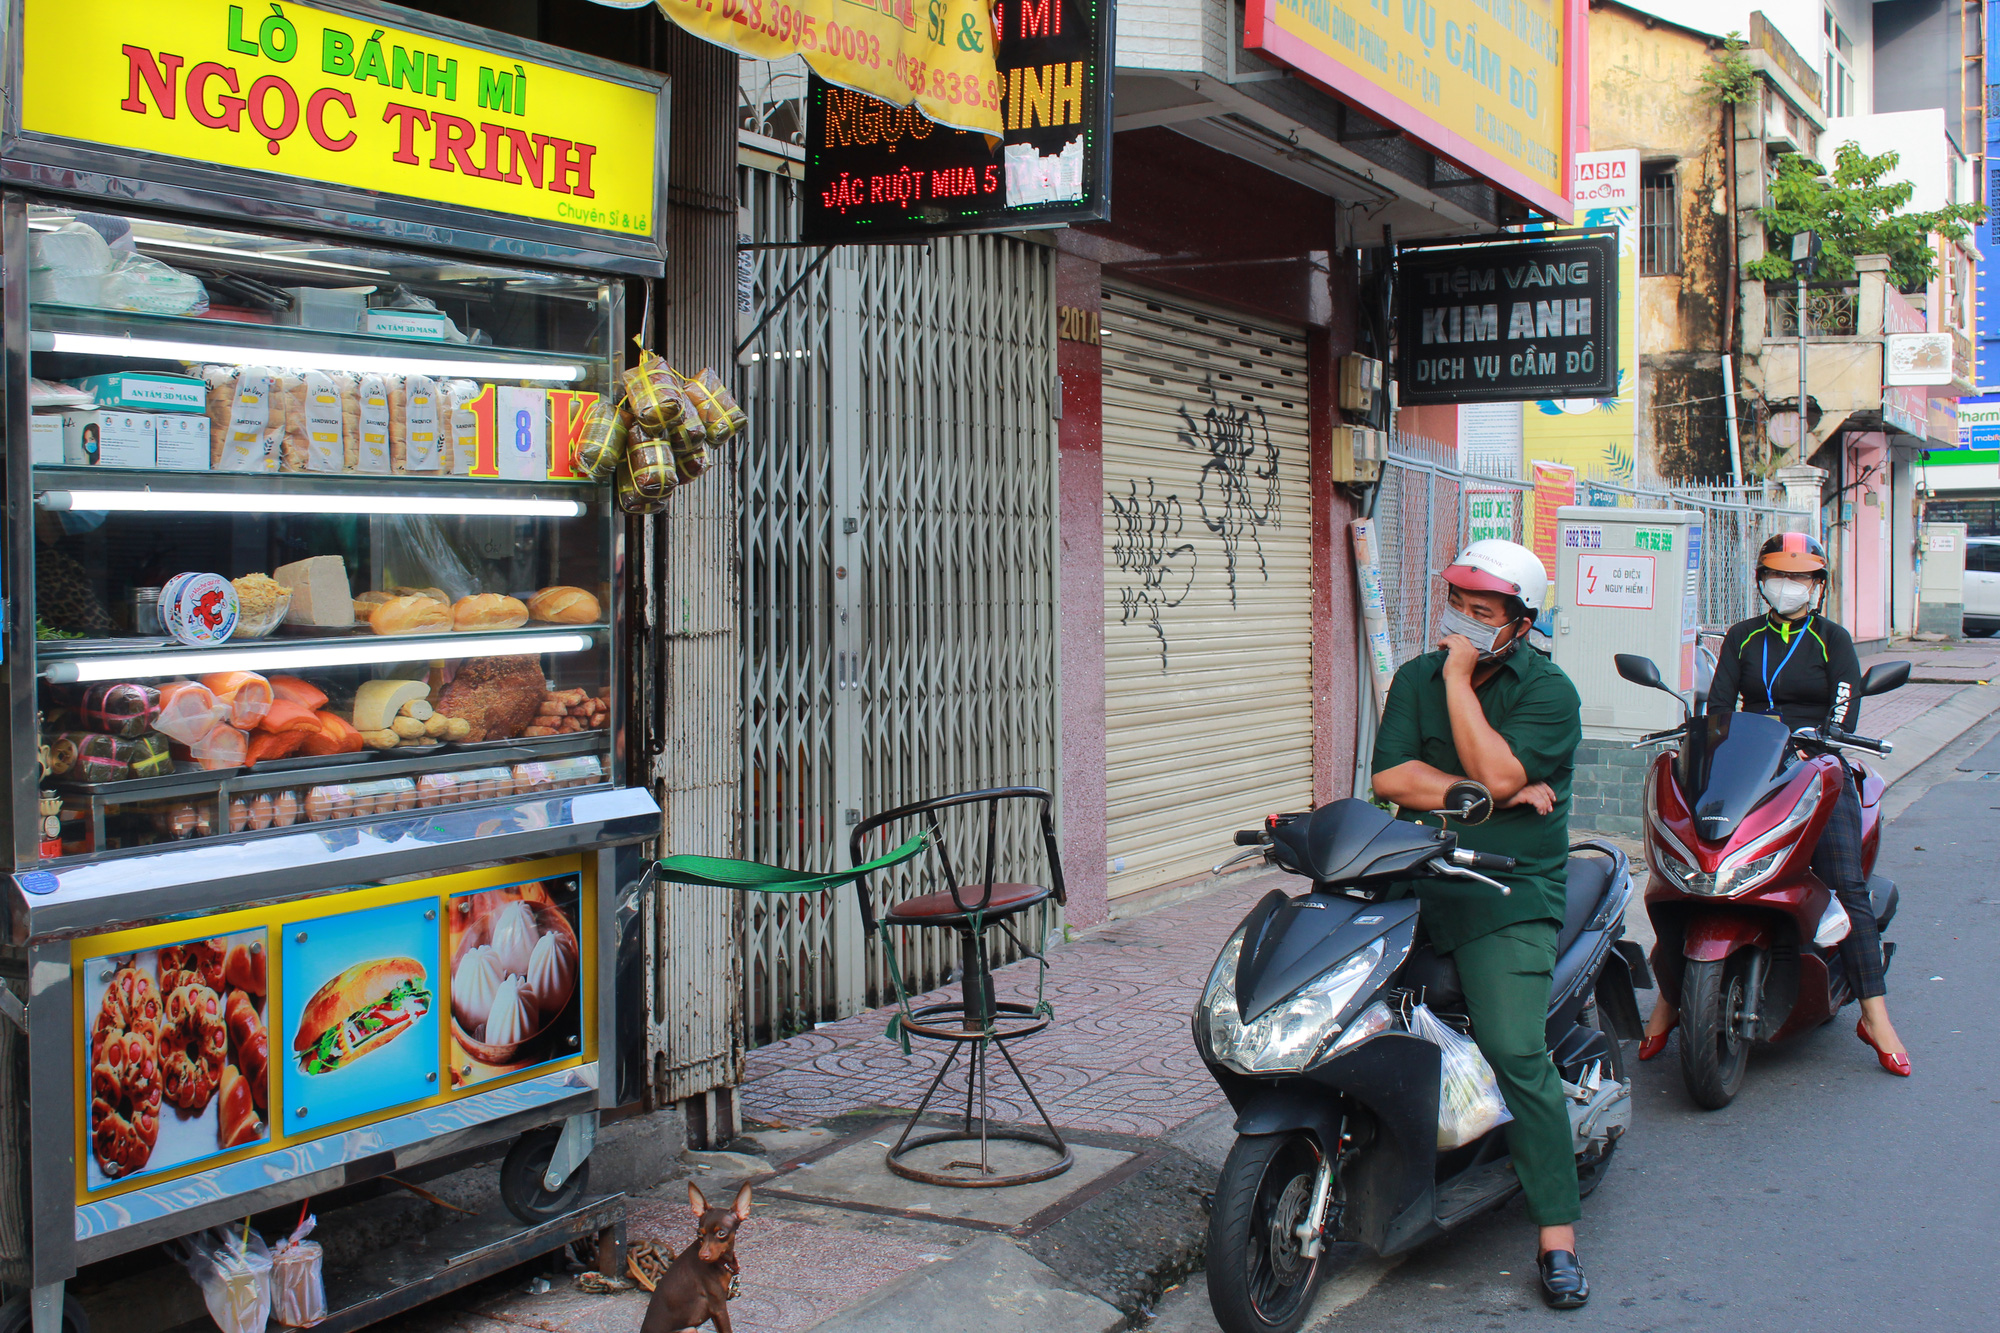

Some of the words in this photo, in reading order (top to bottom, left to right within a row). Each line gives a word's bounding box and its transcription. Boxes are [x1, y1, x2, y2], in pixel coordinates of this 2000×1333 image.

[957, 13, 984, 53] &
[228, 4, 297, 63] LÒ
[322, 29, 457, 101] BÁNH
[478, 66, 525, 116] MÌ
[121, 44, 357, 156] NGỌC
[382, 102, 595, 199] TRINH
[871, 165, 925, 208] RUỘT
[932, 166, 977, 199] MUA
[983, 165, 998, 193] 5
[557, 202, 605, 224] Chuyên
[622, 214, 630, 228] &
[1424, 265, 1496, 299] TIỆM
[1503, 260, 1589, 288] VÀNG
[1422, 304, 1498, 345] KIM
[1507, 298, 1592, 340] ANH
[1417, 358, 1465, 384] DỊCH
[1473, 355, 1500, 381] VỤ
[1509, 344, 1556, 377] CẦM
[1566, 341, 1595, 374] ĐỒ
[1604, 584, 1623, 594] NGUY
